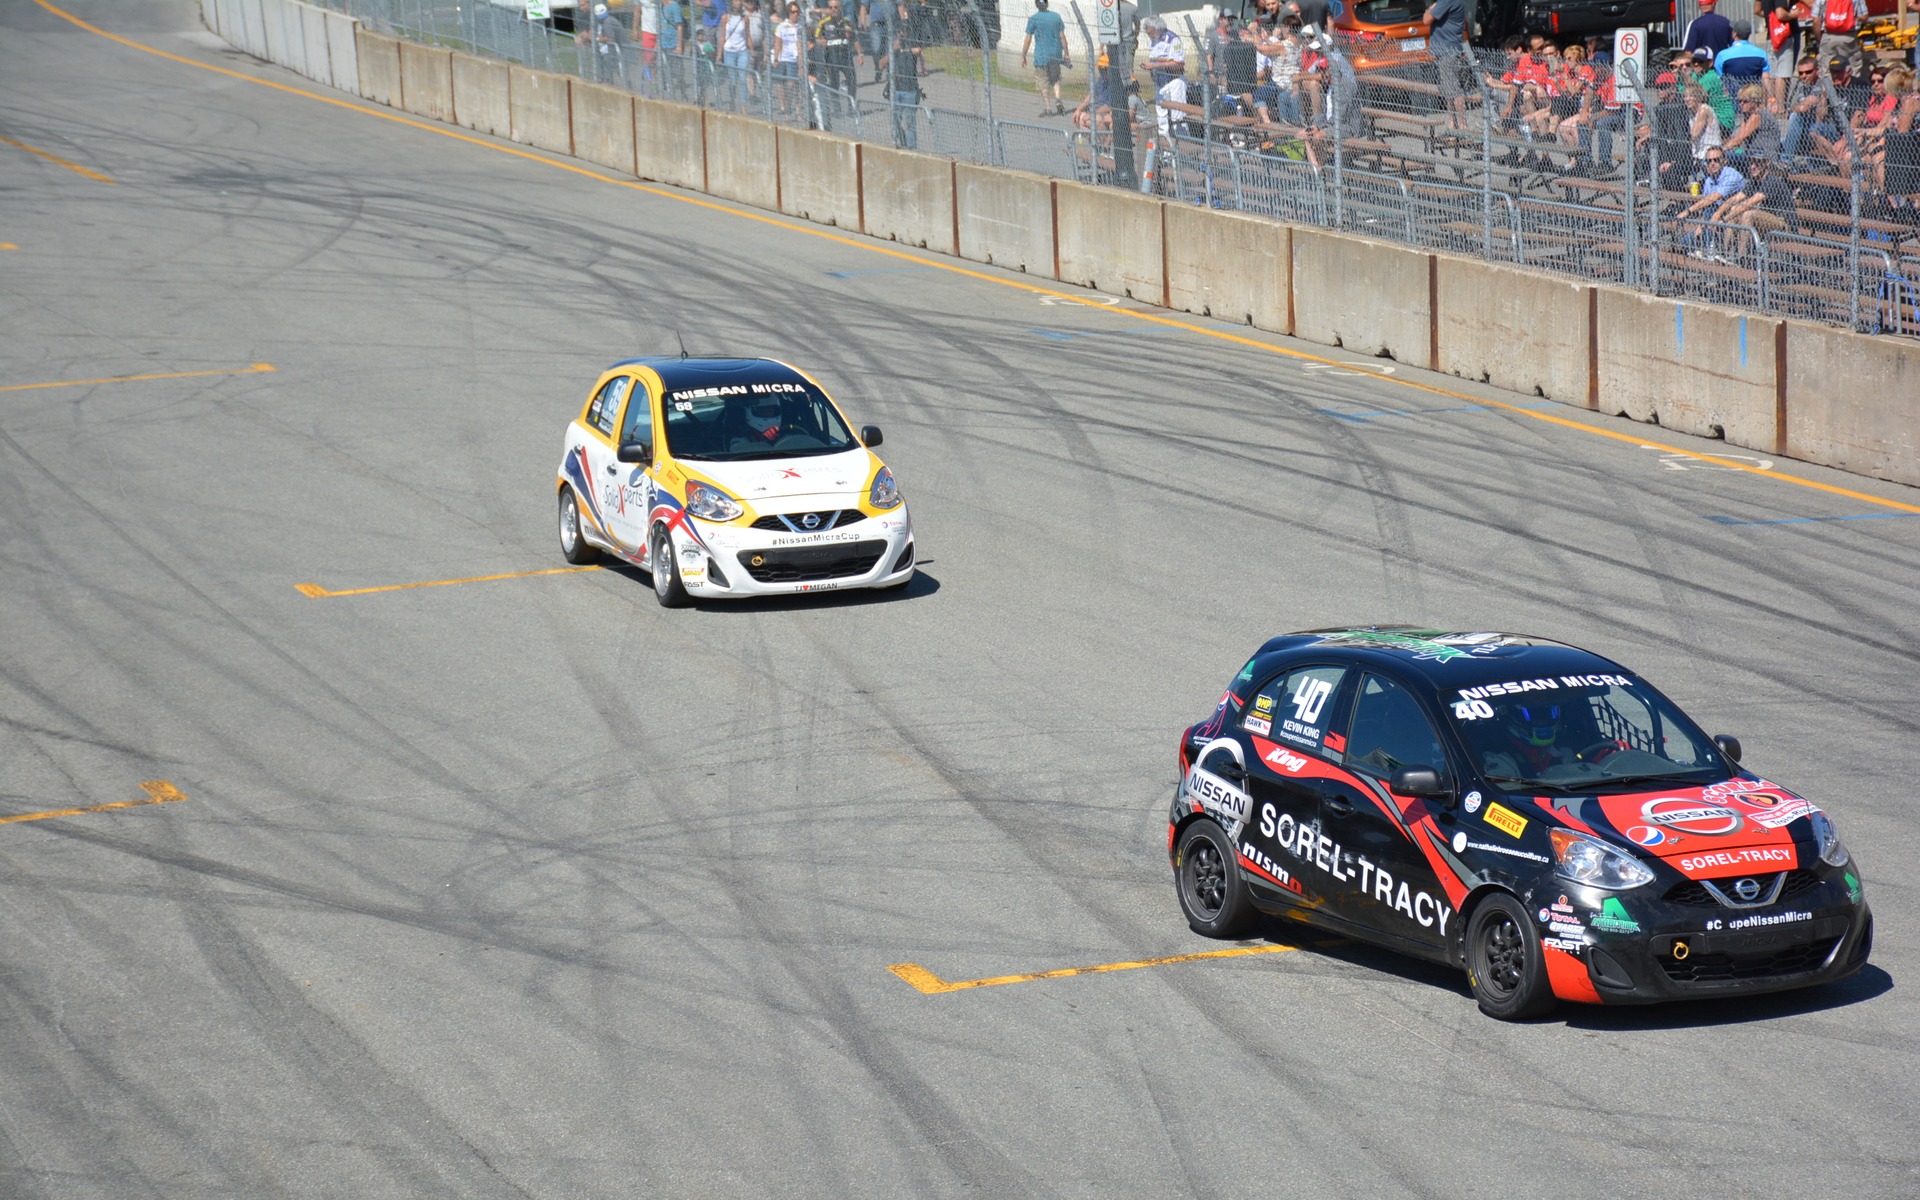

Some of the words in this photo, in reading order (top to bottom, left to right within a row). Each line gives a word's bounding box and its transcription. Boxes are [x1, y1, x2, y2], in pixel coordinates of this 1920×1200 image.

[672, 385, 748, 401] NISSAN
[751, 383, 805, 393] MICRA
[772, 532, 860, 546] #NissanMicraCup
[809, 583, 838, 591] MEGAN
[1458, 678, 1559, 700] NISSAN
[1560, 674, 1633, 688] MICRA
[1257, 697, 1272, 709] OMP
[1292, 675, 1332, 724] 40
[1455, 699, 1494, 721] 40
[1246, 717, 1262, 728] HAWK
[1282, 719, 1304, 734] KEVIN
[1302, 725, 1320, 739] KING
[1265, 747, 1307, 773] King
[1189, 772, 1246, 816] NISSAN
[1488, 807, 1522, 833] PIRELLI
[1651, 808, 1733, 823] NISSAN
[1242, 842, 1303, 894] nismo
[1259, 802, 1451, 936] SOREL-TRACY
[1680, 849, 1792, 871] SOREL-TRACY
[1550, 912, 1580, 925] TOTAL
[1544, 937, 1586, 951] FAST
